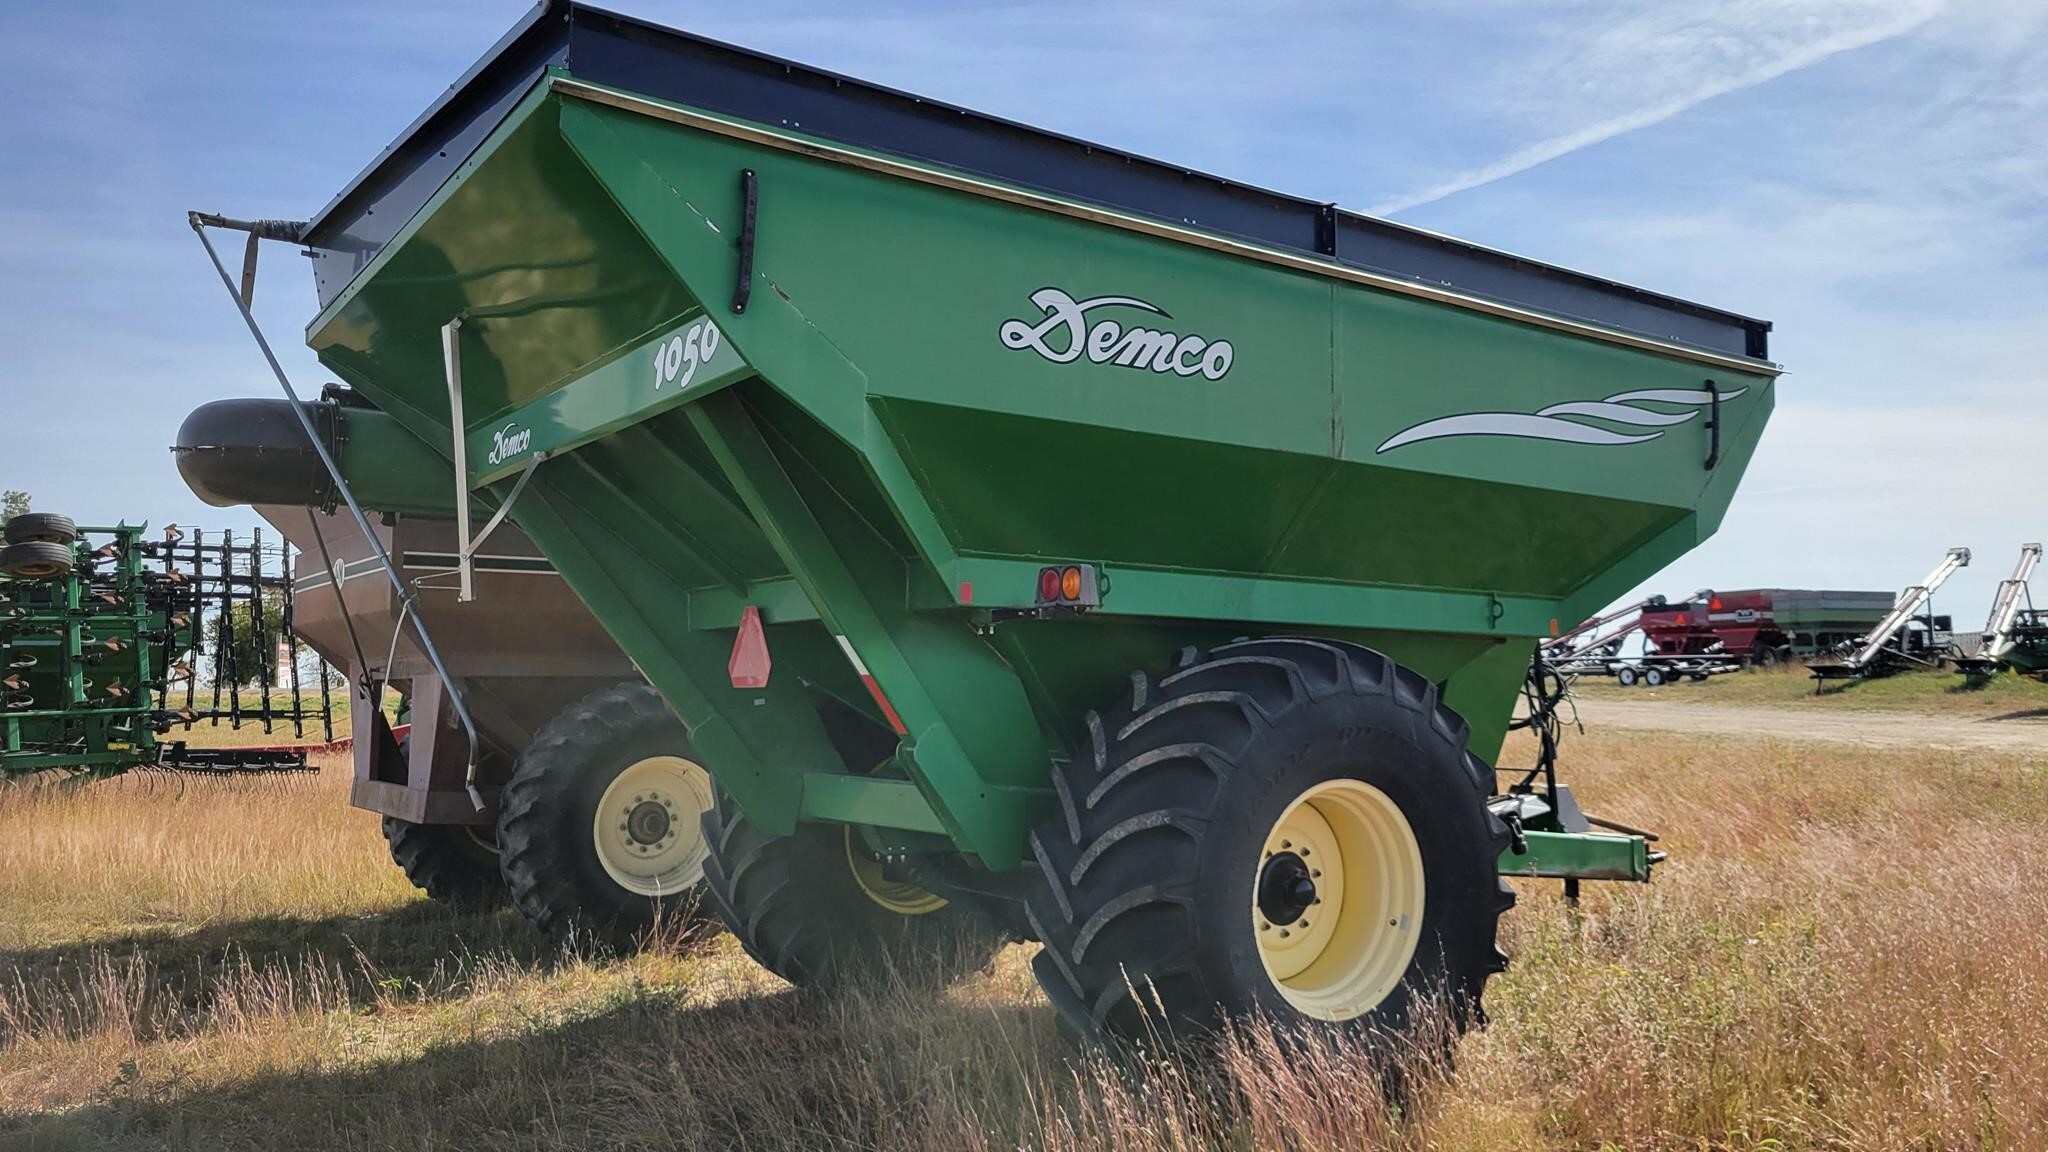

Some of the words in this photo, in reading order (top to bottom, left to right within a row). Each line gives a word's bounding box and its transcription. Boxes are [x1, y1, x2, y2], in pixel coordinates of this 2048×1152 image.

[653, 318, 720, 391] 1050
[999, 286, 1235, 381] Demco
[488, 422, 531, 465] Demco
